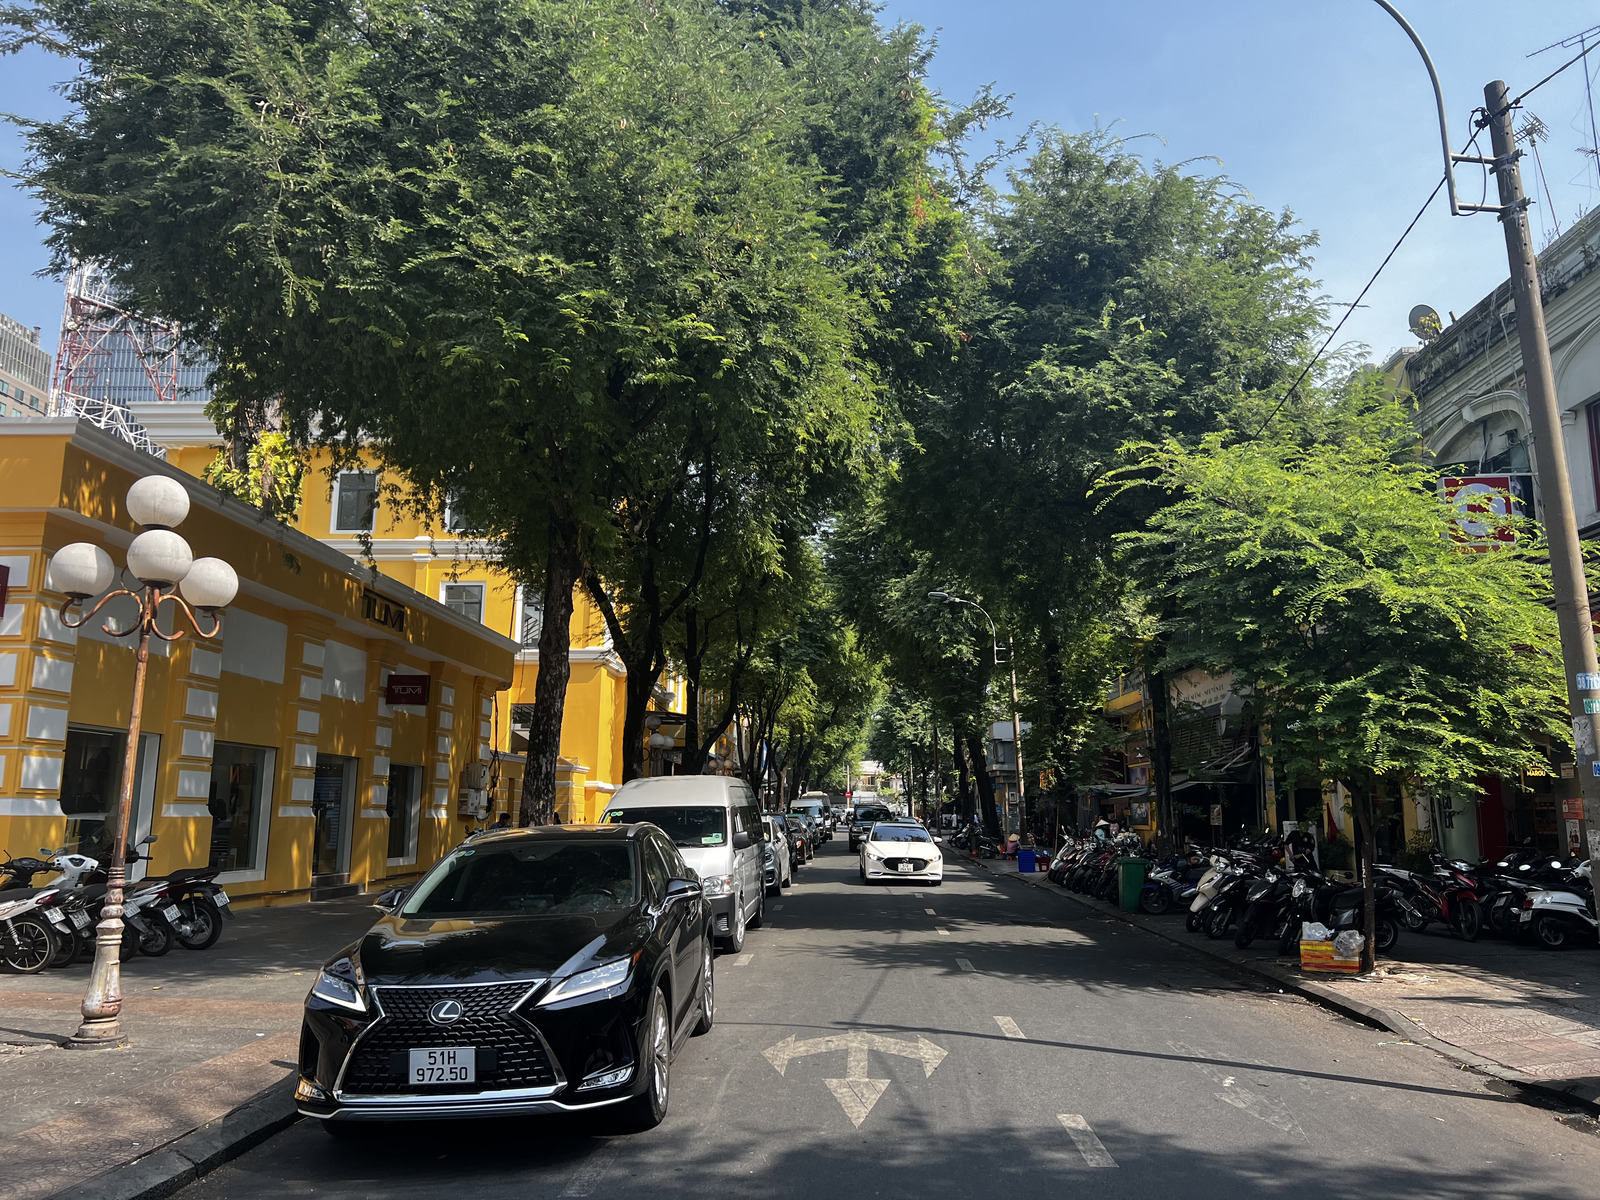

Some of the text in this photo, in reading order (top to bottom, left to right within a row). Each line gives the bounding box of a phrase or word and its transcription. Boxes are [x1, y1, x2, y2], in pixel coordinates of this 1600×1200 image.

[392, 685, 422, 695] TUMI
[428, 1051, 456, 1065] 51H
[416, 1067, 467, 1082] 972.50
